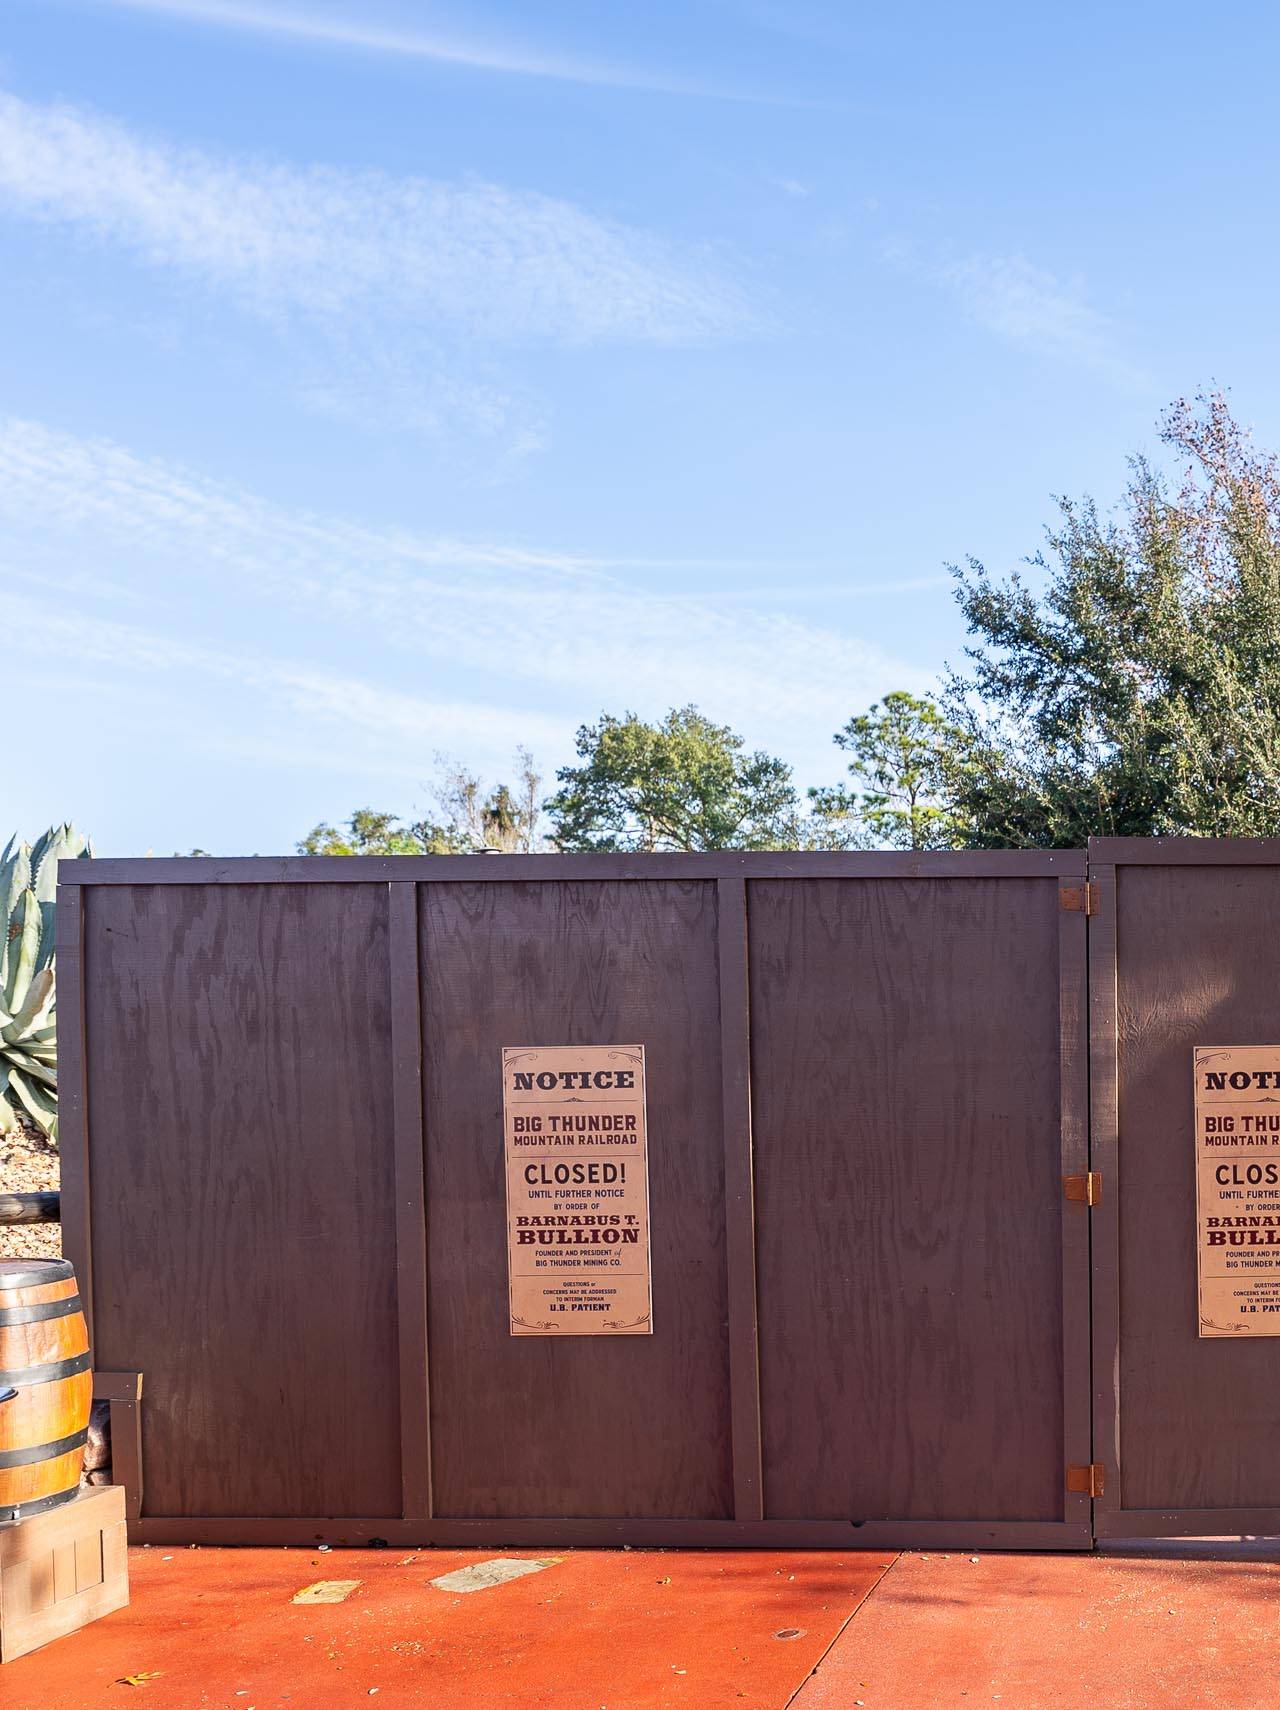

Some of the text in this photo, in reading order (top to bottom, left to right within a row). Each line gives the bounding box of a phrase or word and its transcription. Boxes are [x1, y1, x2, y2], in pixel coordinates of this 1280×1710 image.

[513, 1071, 634, 1090] NOTICE
[514, 1115, 636, 1132] BIG THUNDER
[1205, 1117, 1234, 1132] BIG
[514, 1134, 636, 1146] MOUNTAIN RAILROAD
[1206, 1135, 1267, 1146] MOUNTAIN
[525, 1163, 625, 1184] CLOSED!
[529, 1189, 624, 1198] UNTIL FURTHER NOTICE
[1219, 1191, 1244, 1199] UNTIL
[516, 1215, 639, 1226] BARNABUS T.
[517, 1229, 639, 1244] BULLION
[614, 1248, 622, 1258] of
[1226, 1260, 1238, 1268] BIG
[1241, 1260, 1273, 1268] THUNDER
[550, 1304, 568, 1312] U.B.
[1240, 1305, 1259, 1313] U.B.
